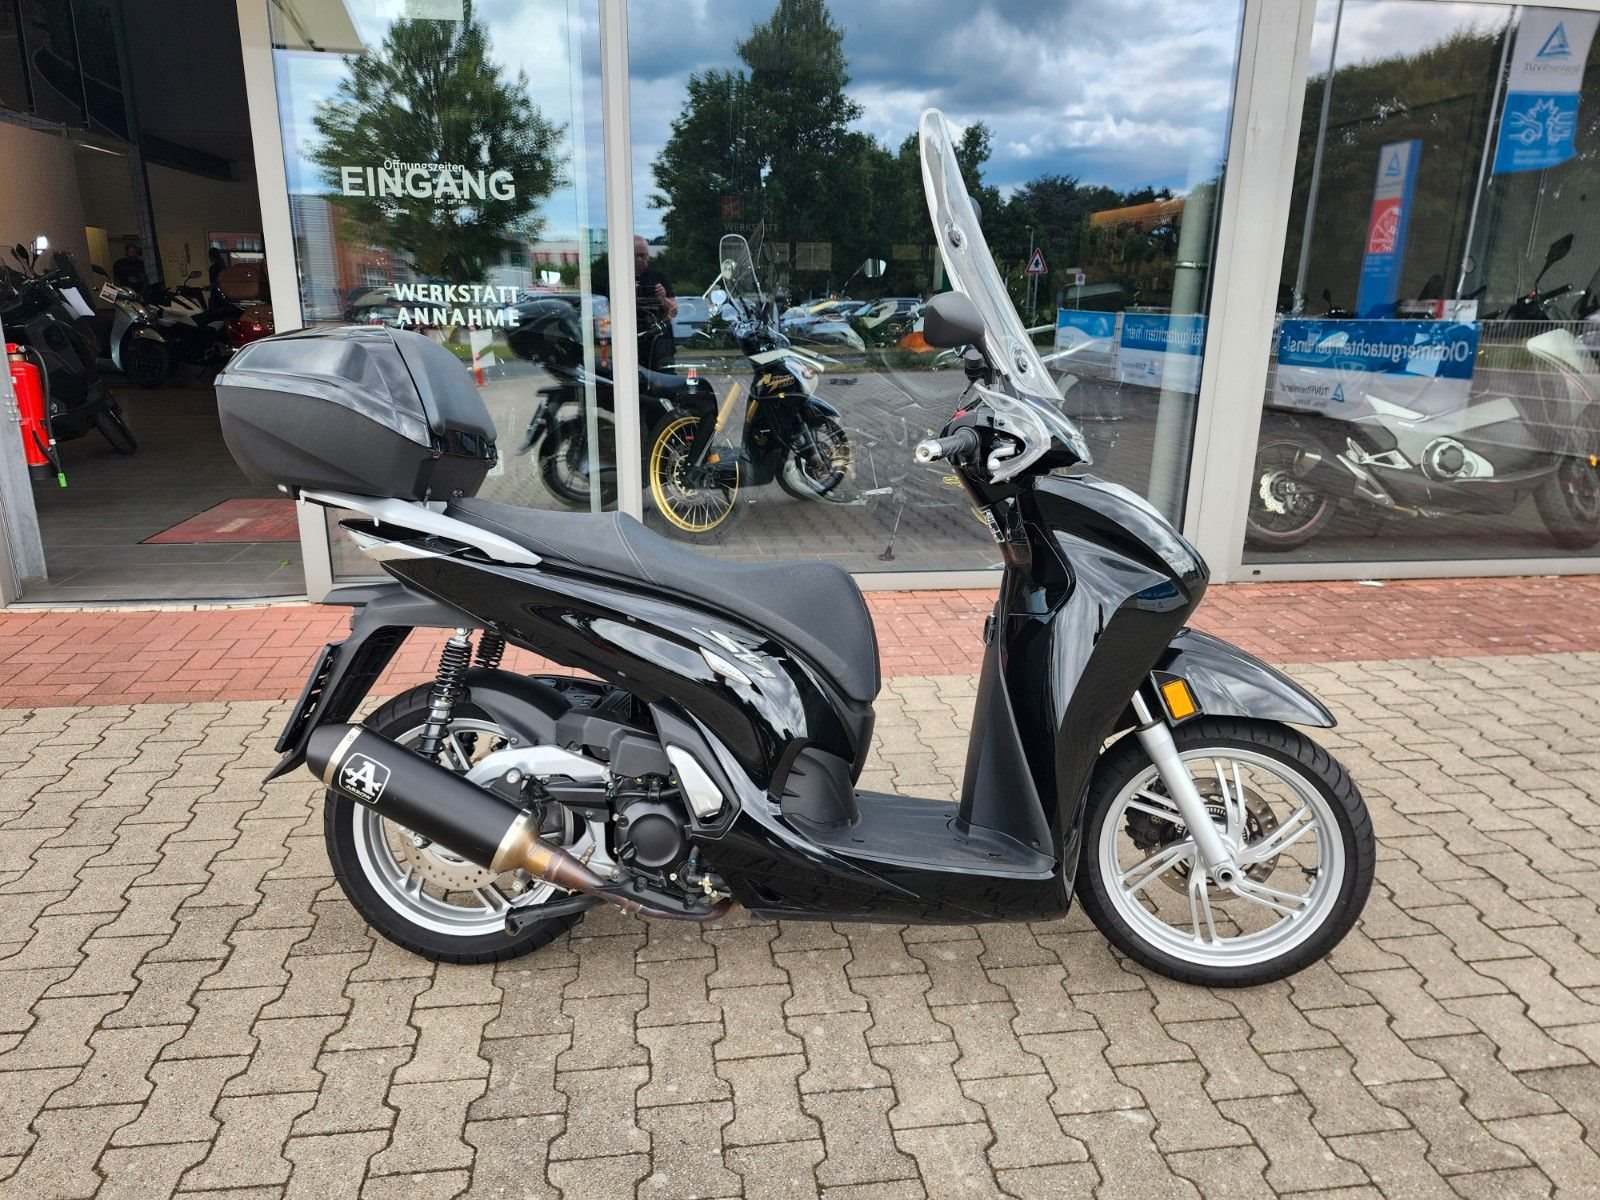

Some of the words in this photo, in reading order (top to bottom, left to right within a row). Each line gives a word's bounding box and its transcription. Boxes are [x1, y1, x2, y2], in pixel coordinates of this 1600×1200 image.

[384, 157, 465, 172] Öffnungszeiten
[341, 166, 515, 200] EINGANG
[724, 223, 779, 232] WERKSTATT
[394, 283, 519, 303] WERKSTATT
[397, 307, 520, 327] ANNAHME
